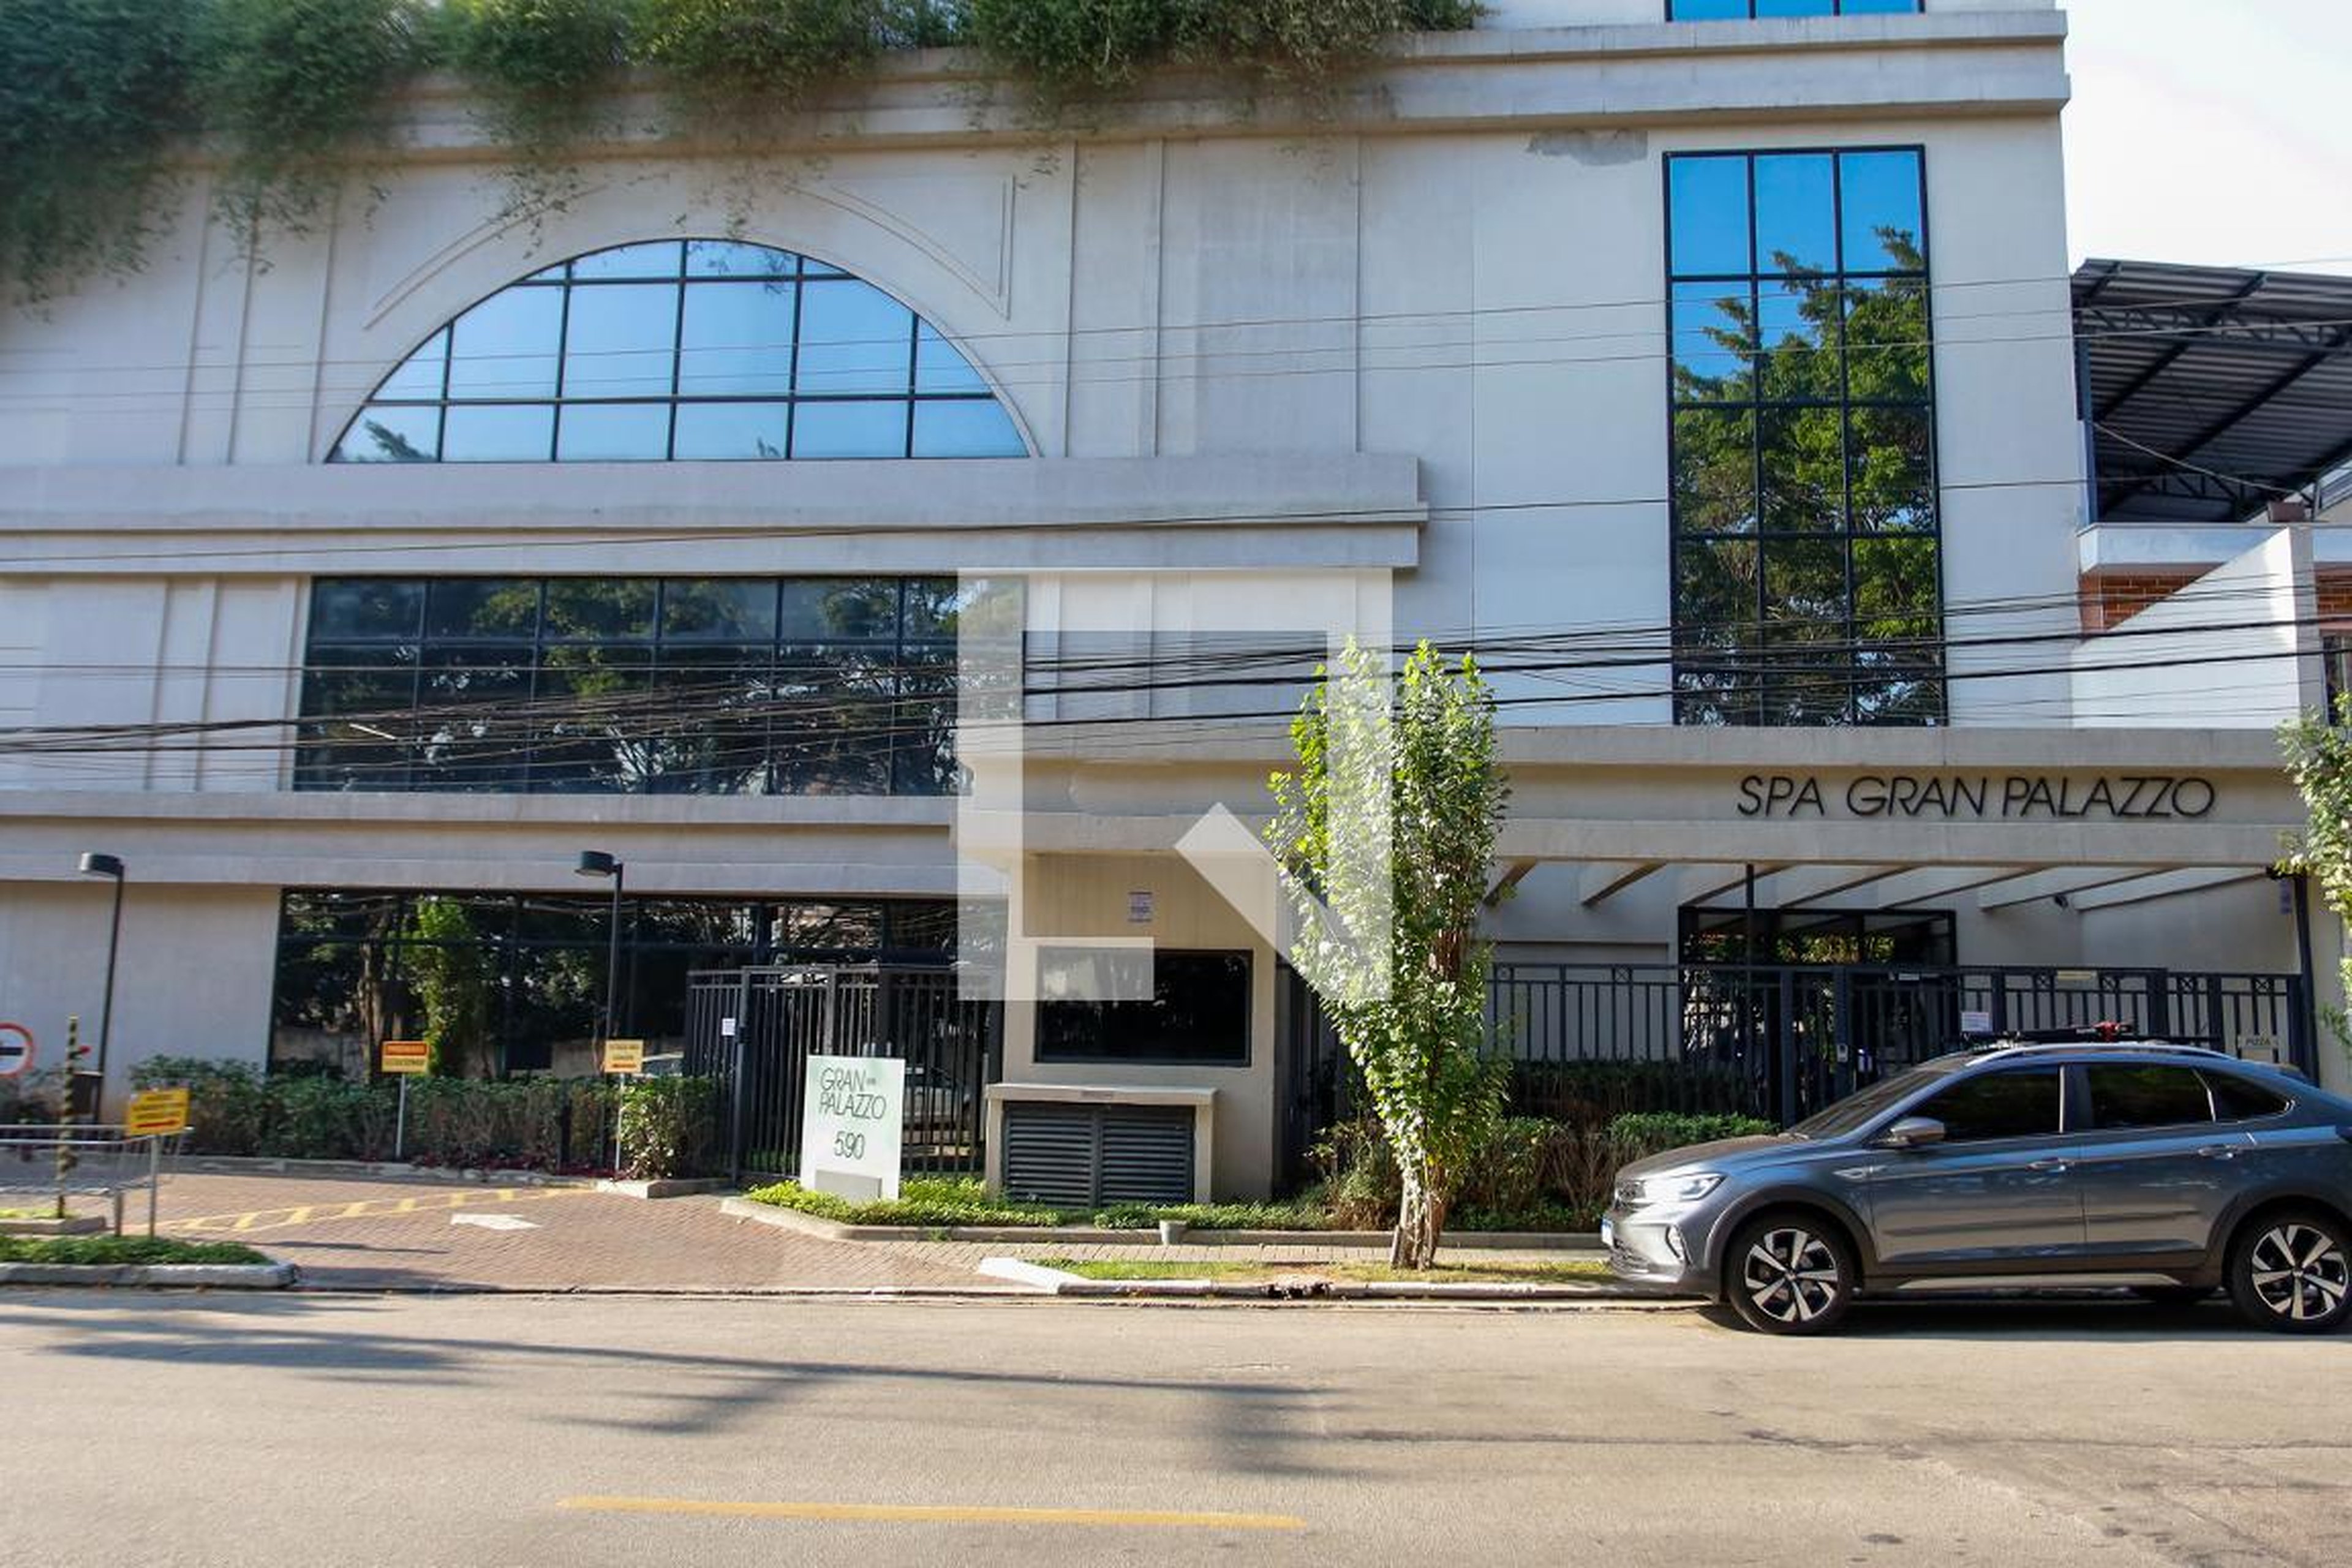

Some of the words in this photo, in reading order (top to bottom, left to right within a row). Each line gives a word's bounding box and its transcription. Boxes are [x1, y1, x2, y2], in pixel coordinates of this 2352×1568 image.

[1737, 775, 1825, 816] SPA
[1846, 775, 1987, 816] GRAN
[2002, 775, 2215, 817] PALAZZO
[821, 1067, 866, 1091] GRAN
[819, 1093, 886, 1120] PALAZZO
[834, 1131, 865, 1159] 590
